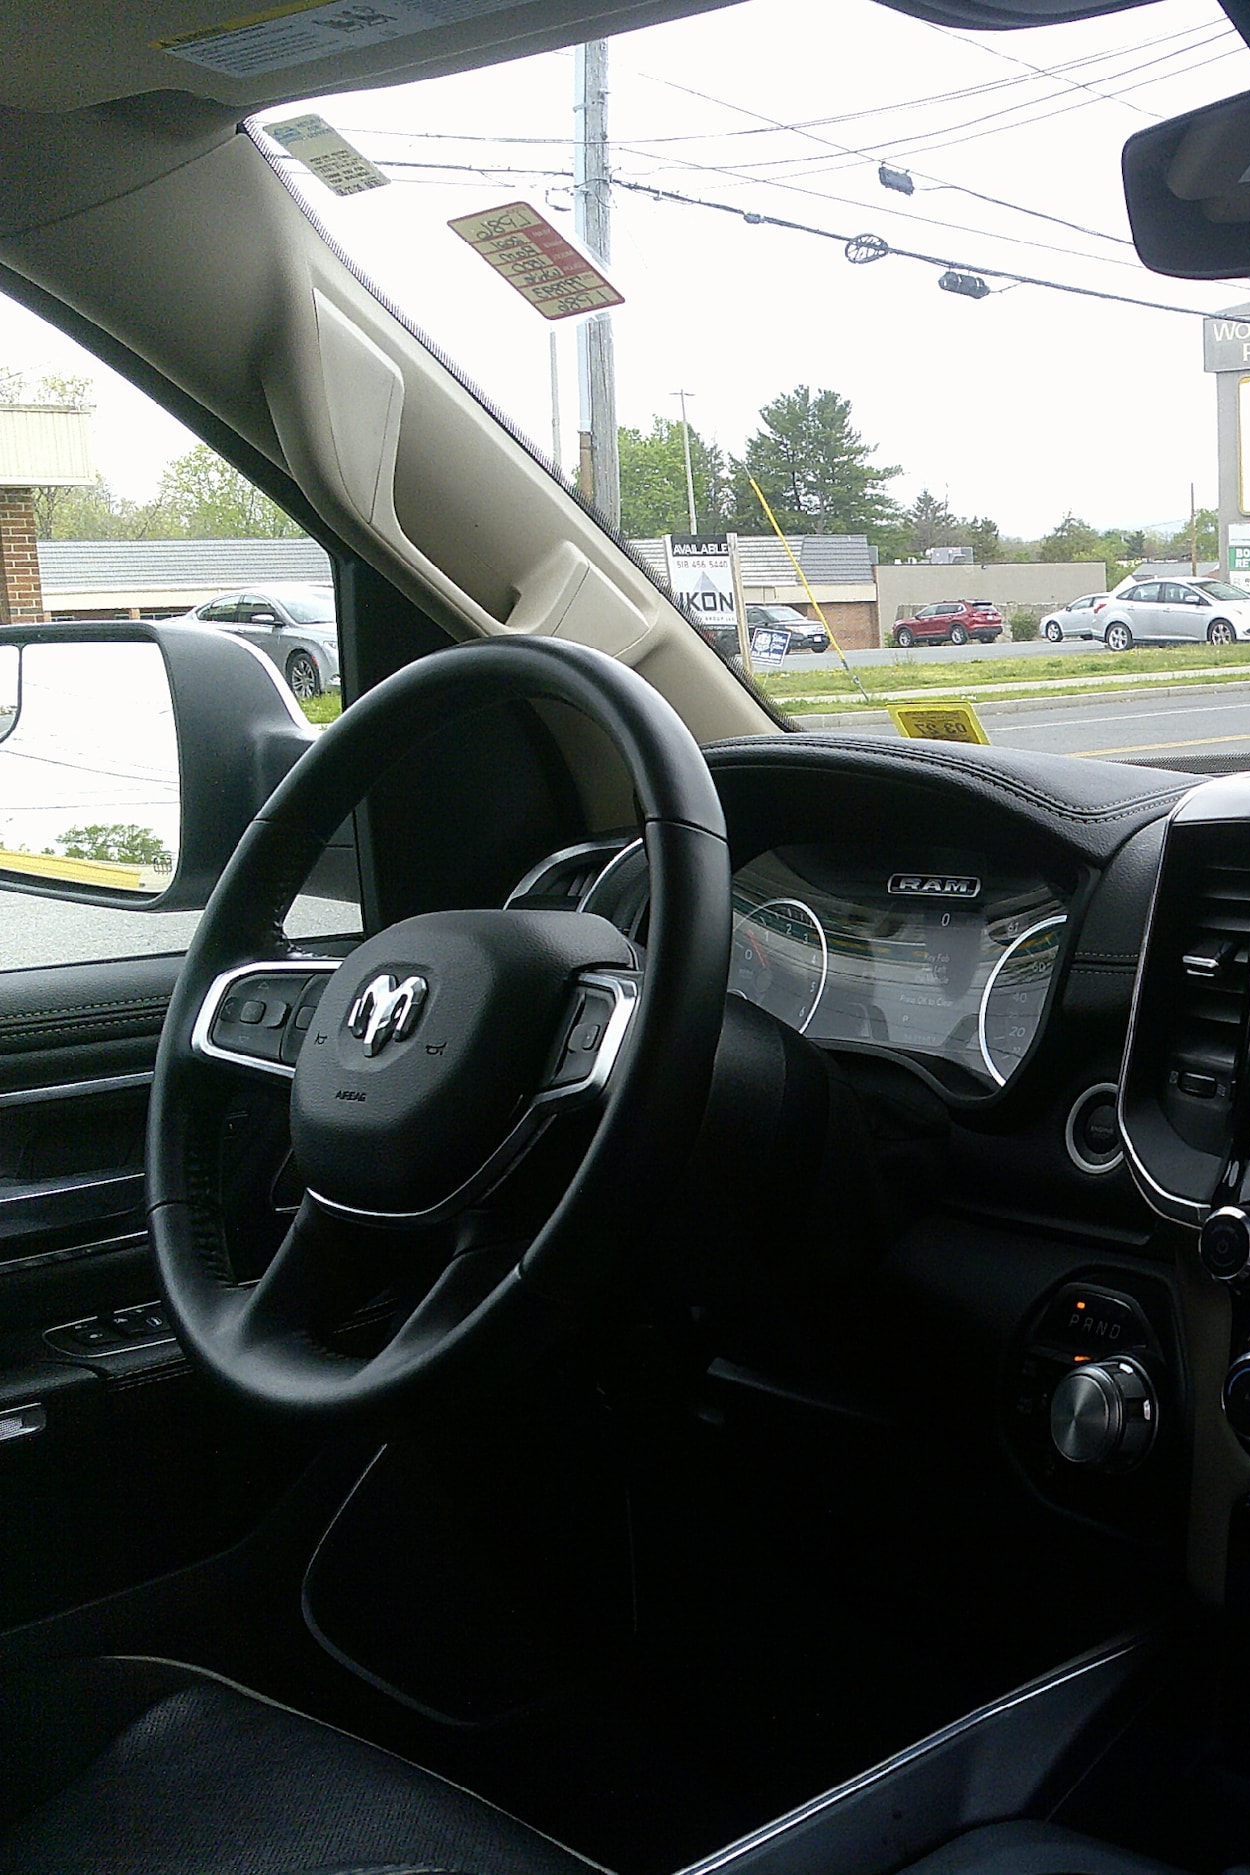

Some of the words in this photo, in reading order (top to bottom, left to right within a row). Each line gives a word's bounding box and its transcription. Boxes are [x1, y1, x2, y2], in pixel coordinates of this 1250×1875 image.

[673, 543, 729, 555] AVAILABLE
[899, 878, 969, 893] RAM
[941, 912, 951, 927] 0
